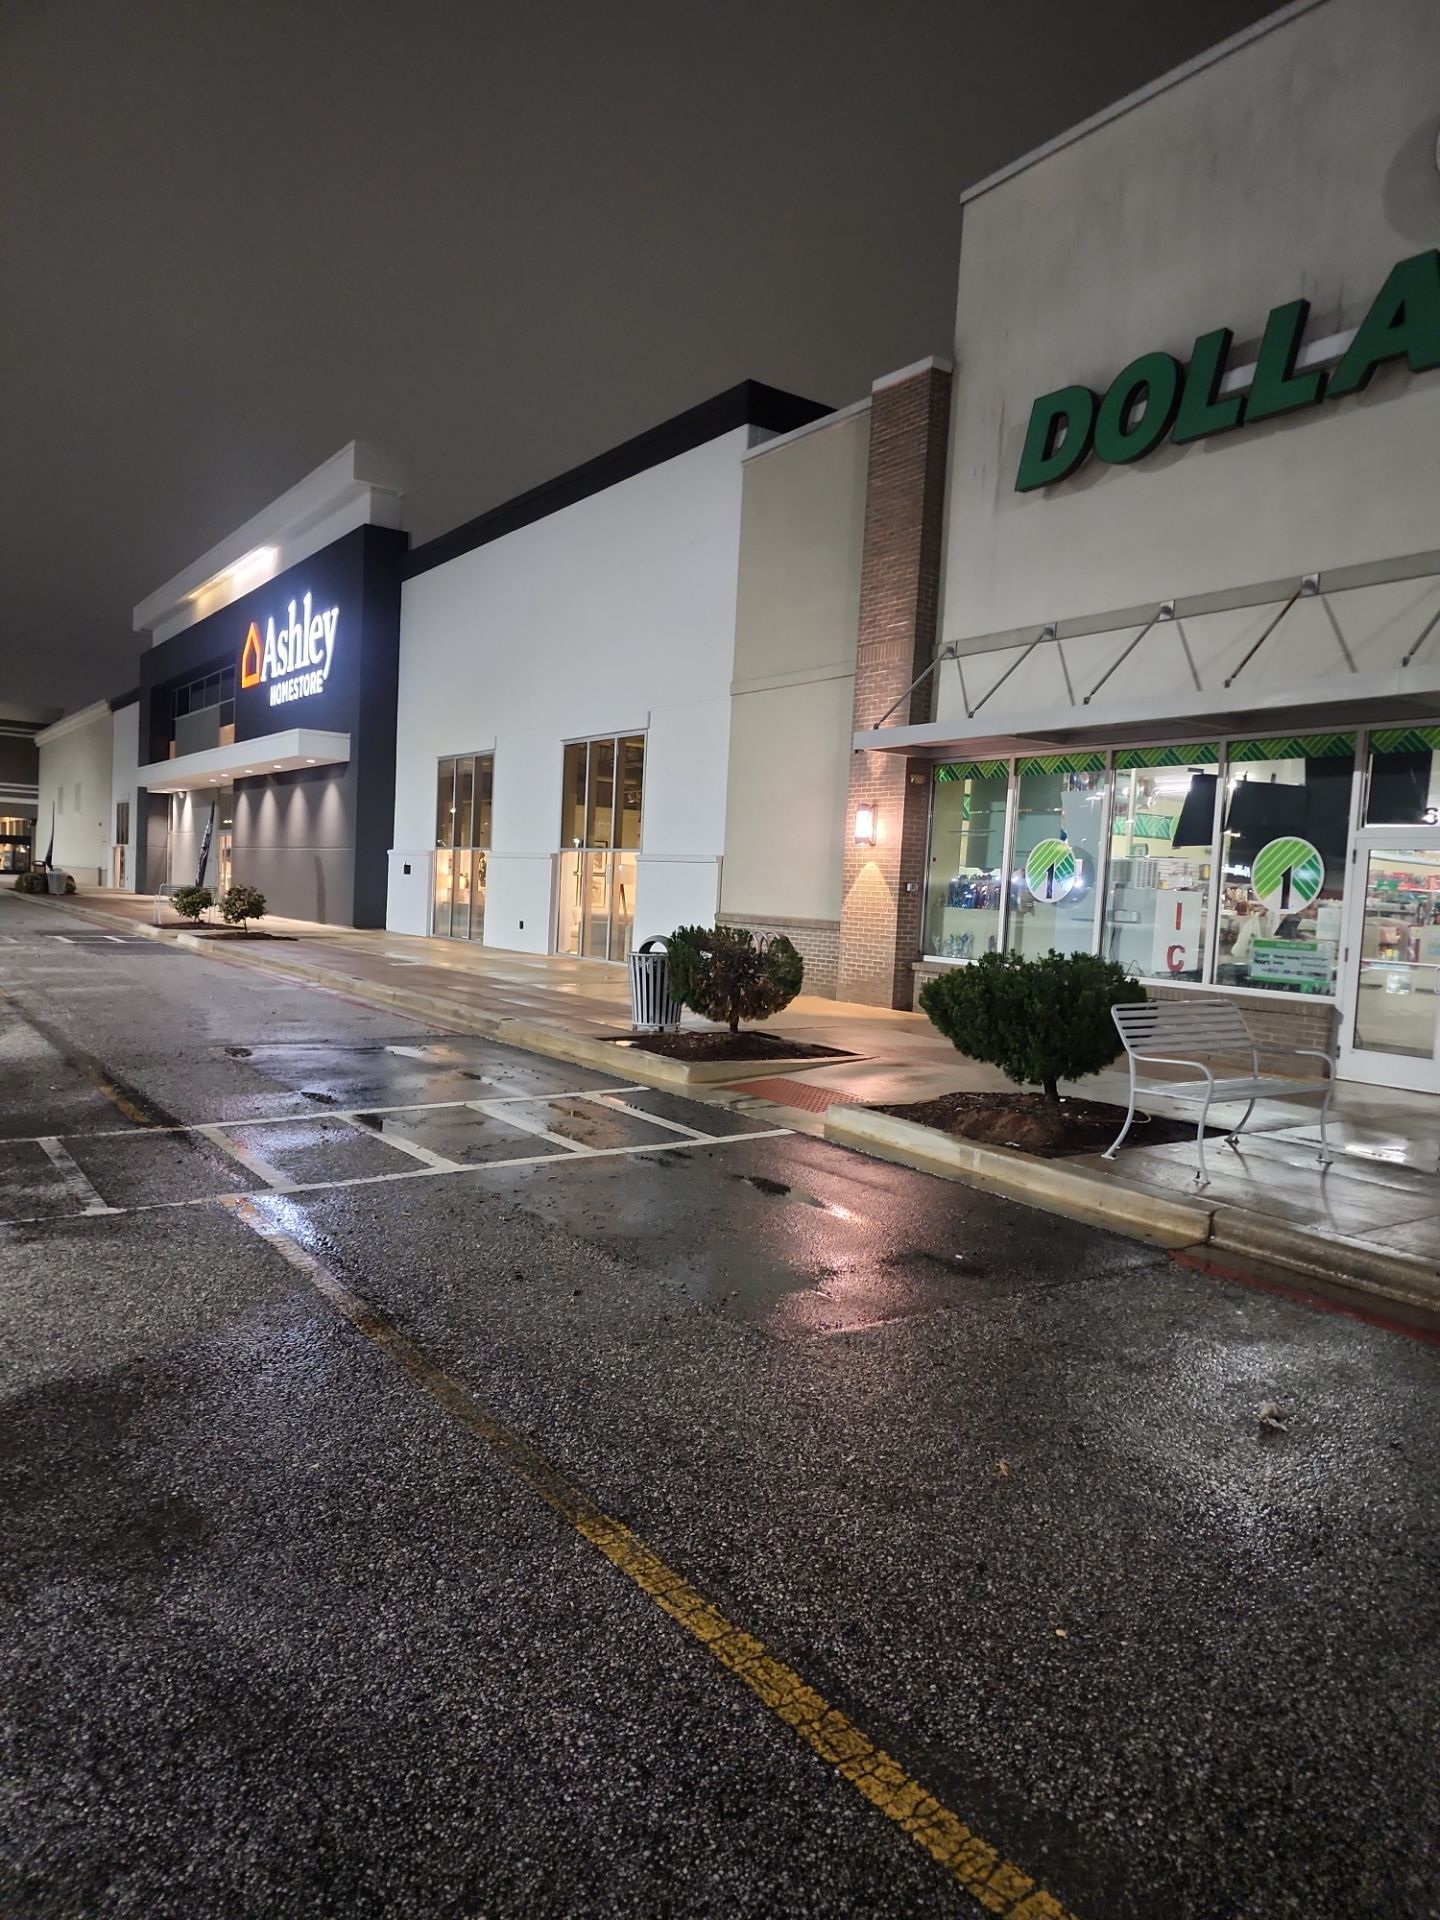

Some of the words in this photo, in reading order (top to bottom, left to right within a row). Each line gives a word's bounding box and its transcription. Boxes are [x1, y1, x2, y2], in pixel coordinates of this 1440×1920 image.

[1015, 248, 1440, 493] DOLLA
[260, 591, 339, 682] Ashley
[269, 669, 324, 707] HOMESTORE
